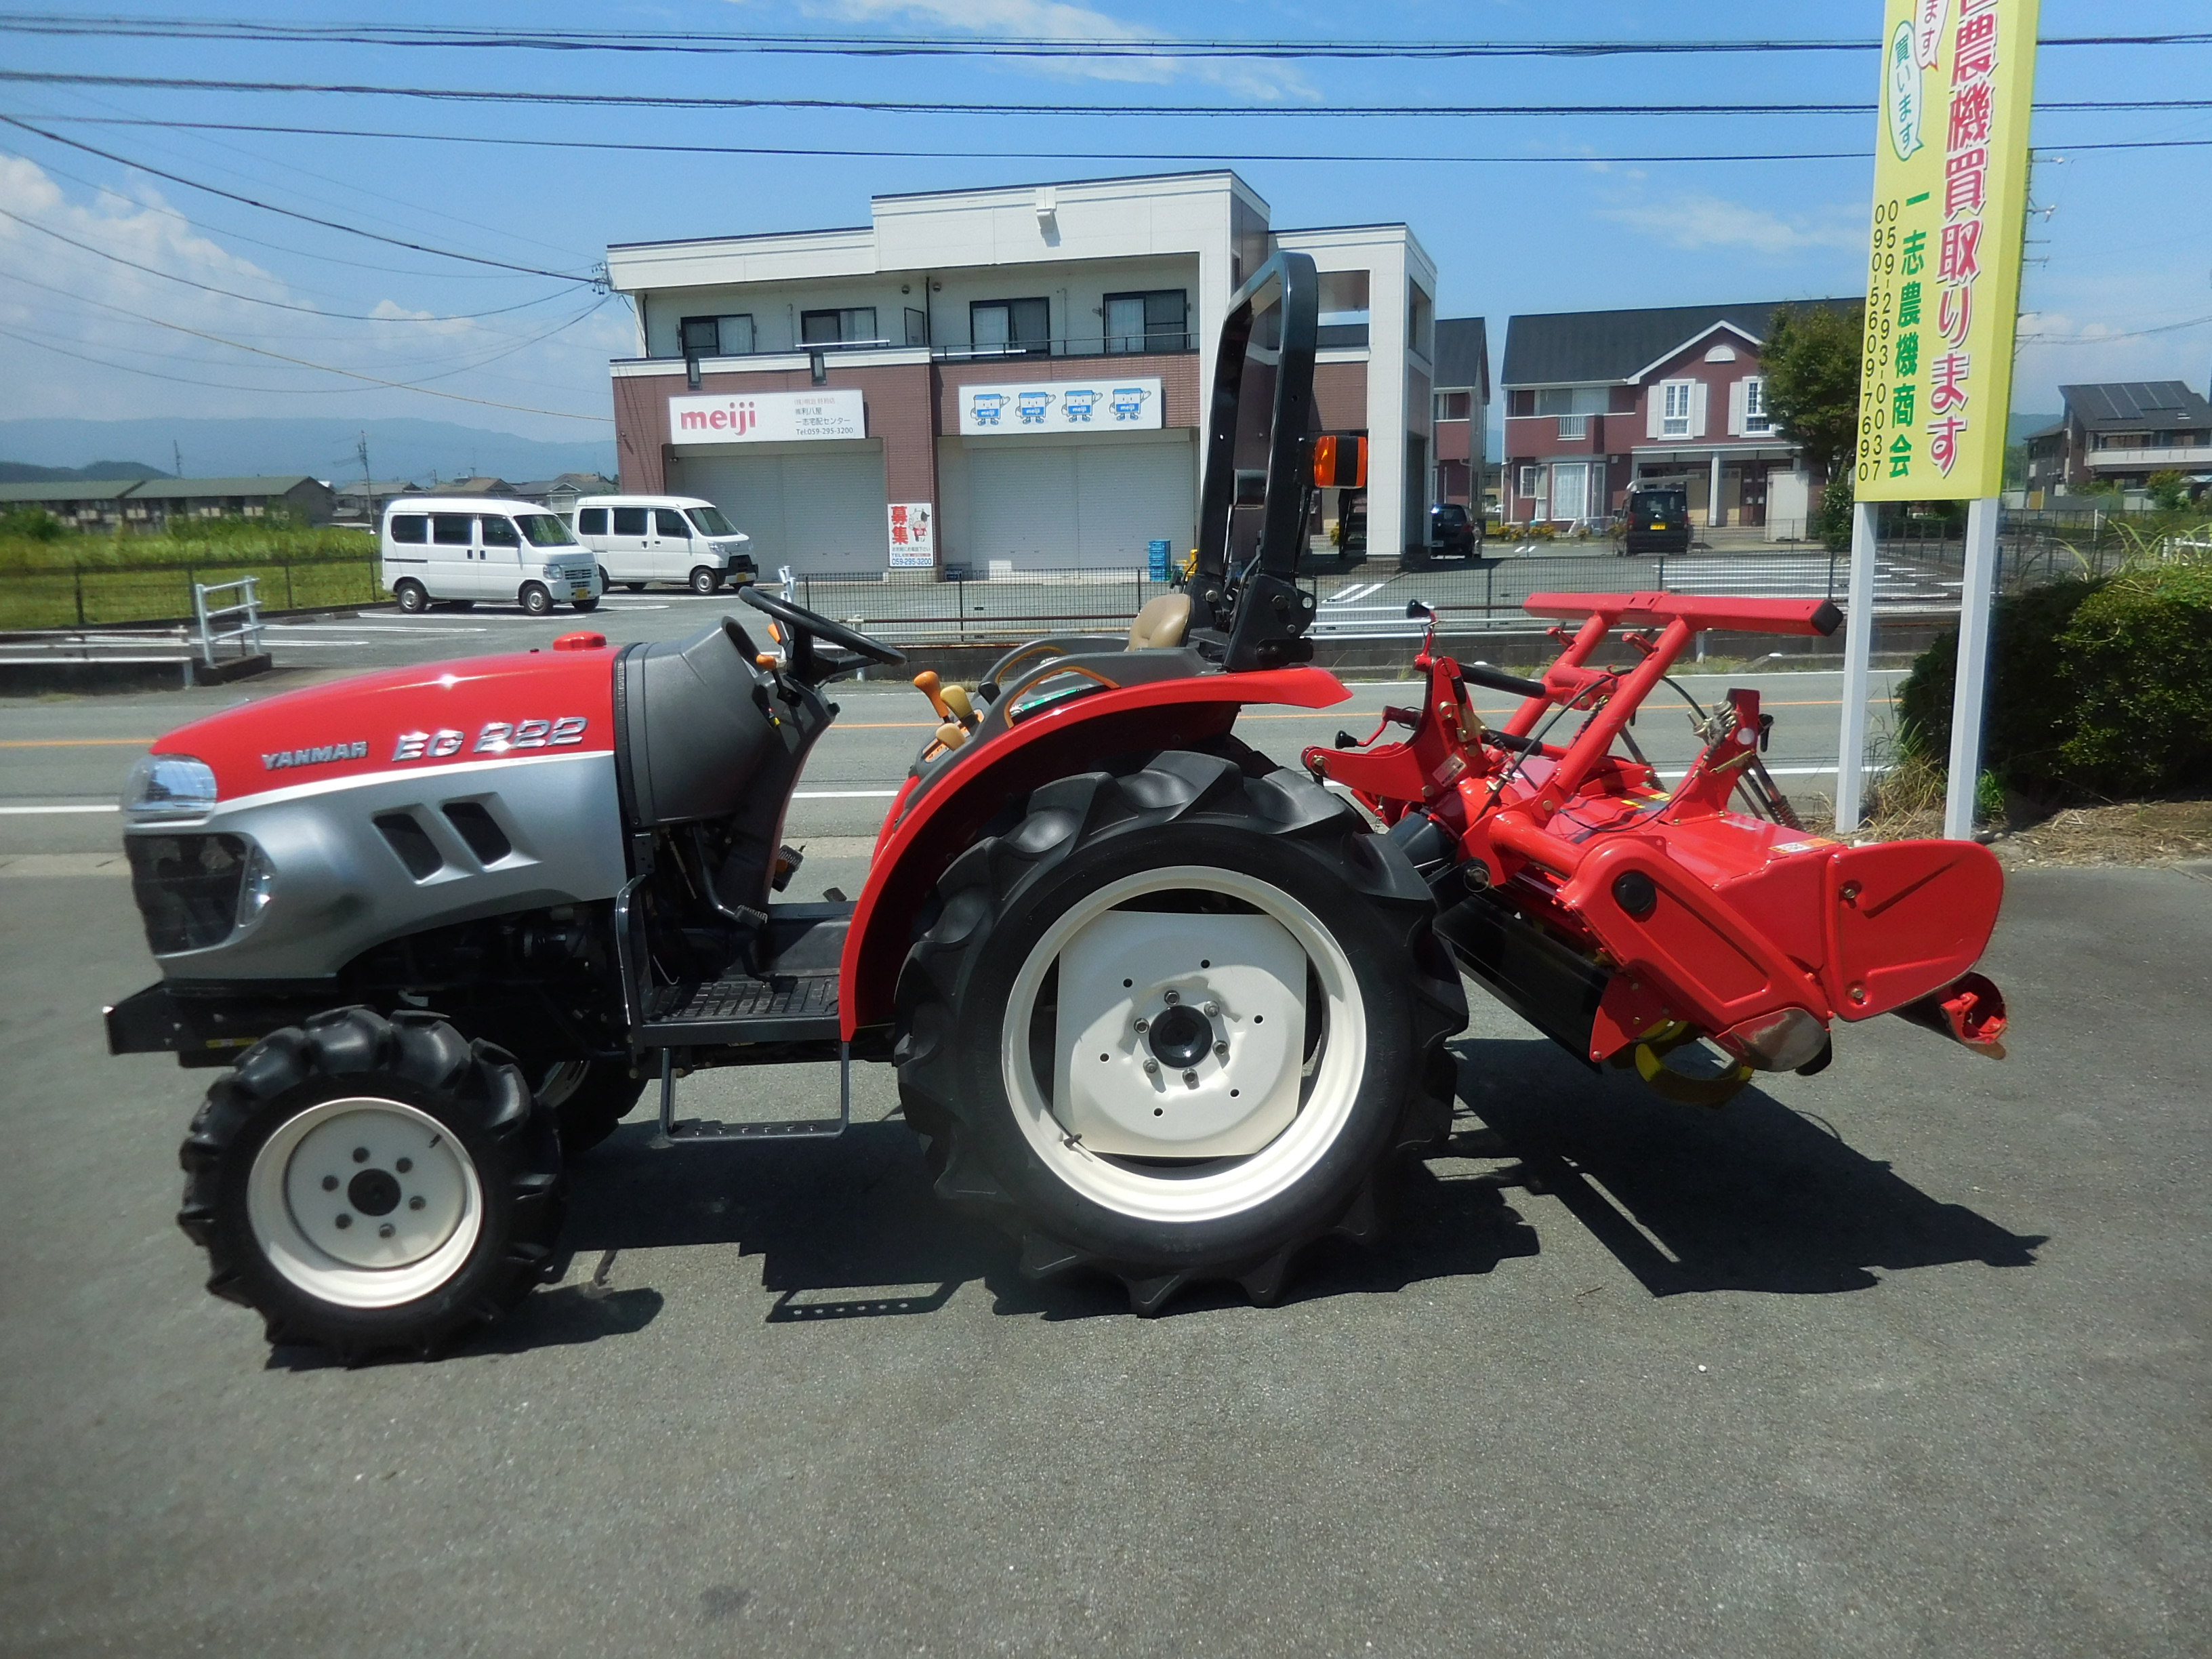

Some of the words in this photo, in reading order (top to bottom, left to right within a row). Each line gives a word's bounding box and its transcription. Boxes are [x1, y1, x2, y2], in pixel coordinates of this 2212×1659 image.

[1896, 34, 1912, 151] 買います
[1858, 204, 1885, 482] 090-5609-7690
[1872, 199, 1898, 480] 059-293-0037
[1889, 192, 1930, 478] 一志農機商会
[680, 401, 756, 436] meiji
[796, 417, 851, 426] 一志宅配センター
[891, 506, 909, 545] 募集
[262, 741, 367, 770] YANMAR
[392, 729, 464, 762] EG
[473, 717, 588, 754] 222
